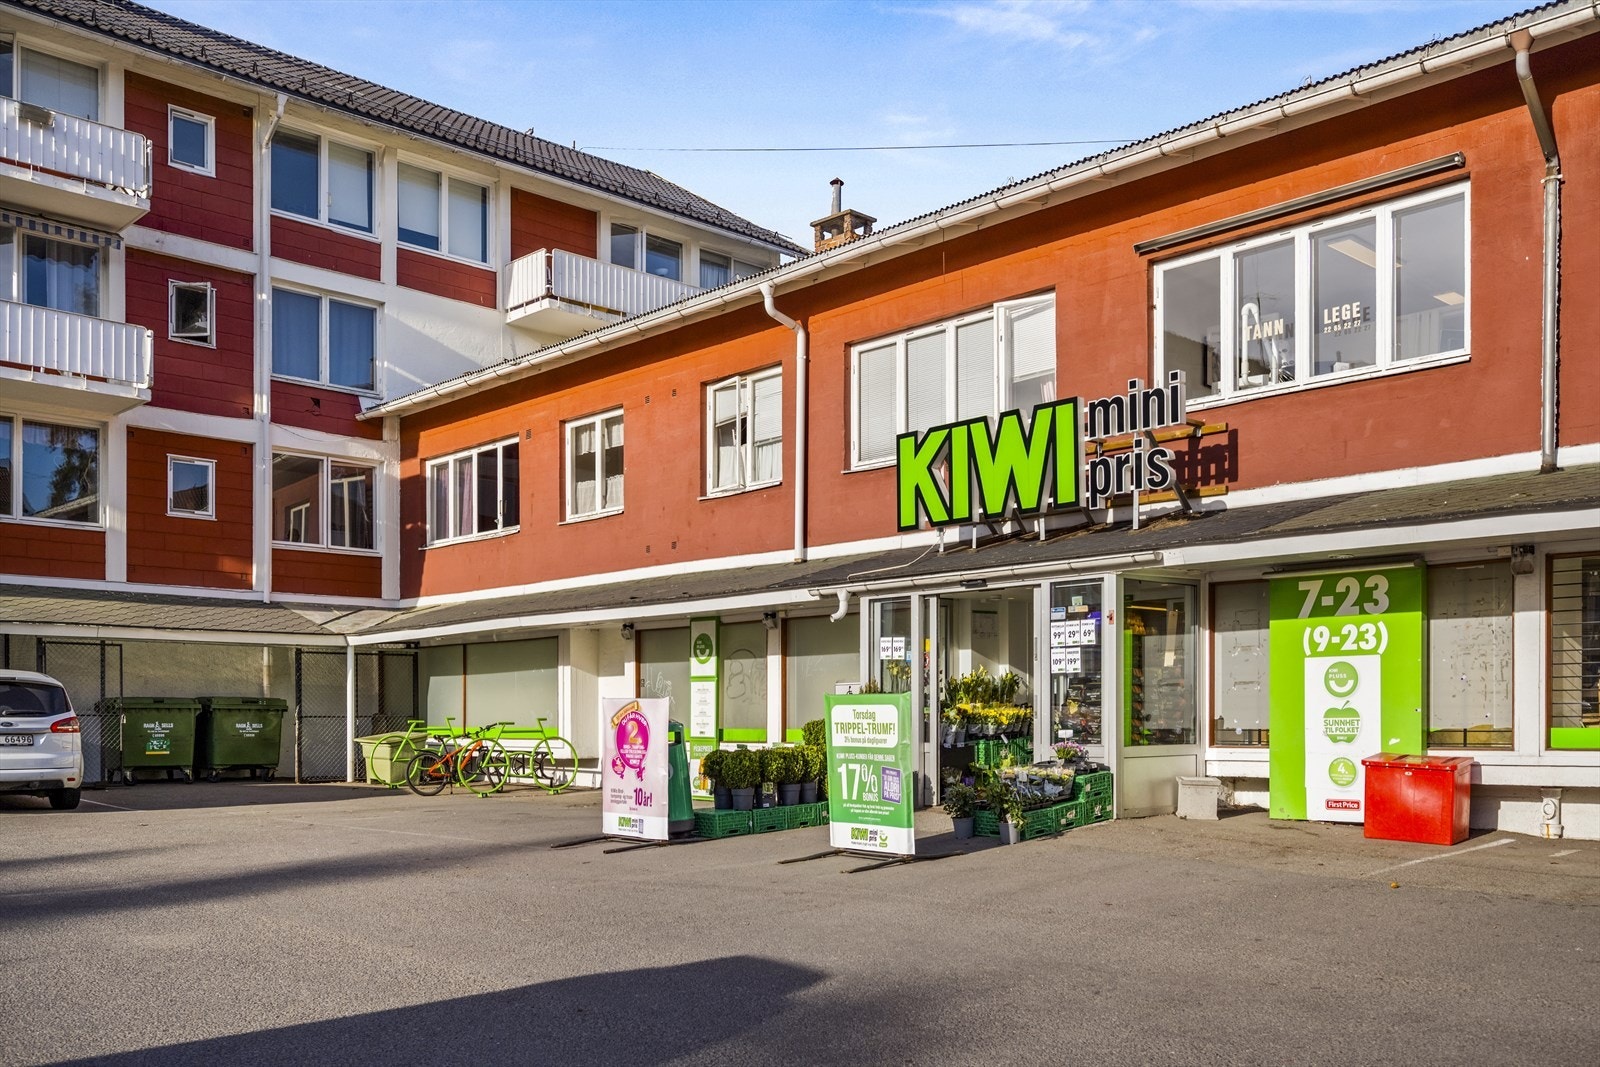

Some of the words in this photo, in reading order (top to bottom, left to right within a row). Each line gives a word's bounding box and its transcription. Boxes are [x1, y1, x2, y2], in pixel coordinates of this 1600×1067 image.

[1324, 301, 1360, 324] LEGE
[1088, 370, 1186, 438] mini
[897, 396, 1080, 532] KIWI
[1089, 437, 1171, 510] pris
[1298, 574, 1390, 618] 7-23
[1303, 621, 1388, 656] (9-23)
[852, 709, 876, 722] Torsdag
[834, 722, 896, 735] TRIPPEL-TRUMF!
[4, 736, 32, 744] 66496
[838, 763, 878, 800] 17%
[884, 780, 900, 794] ALDRI
[634, 788, 643, 806] 10
[643, 792, 652, 807] år!
[862, 792, 878, 802] BONUS
[618, 816, 632, 828] KIWI
[851, 827, 868, 840] KIWI
